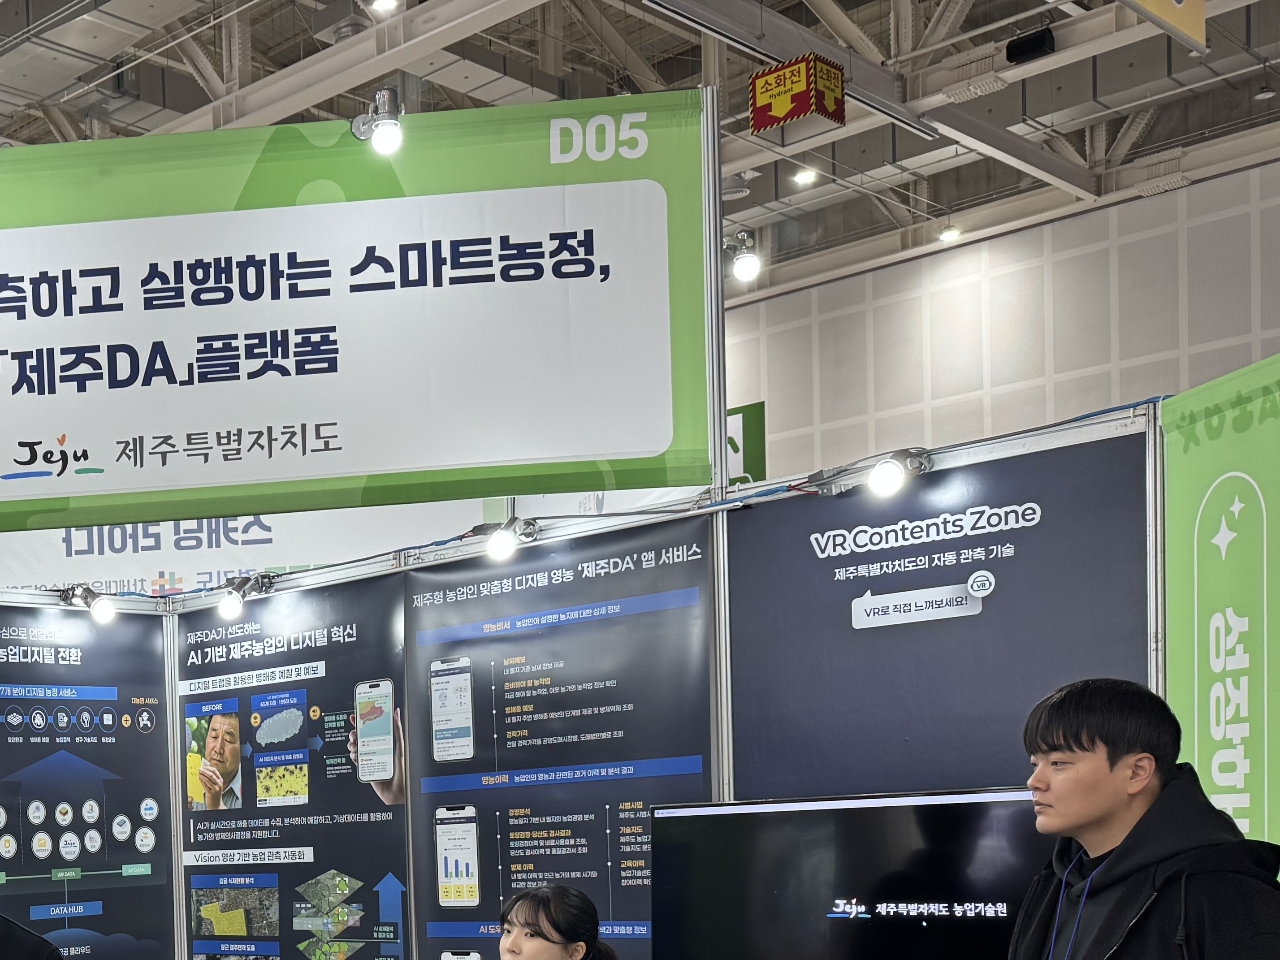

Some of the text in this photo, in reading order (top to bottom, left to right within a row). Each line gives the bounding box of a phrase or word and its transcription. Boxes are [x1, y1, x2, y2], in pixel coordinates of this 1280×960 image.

[760, 66, 801, 94] 소화전
[818, 66, 840, 89] 소화전
[769, 87, 794, 100] Hydrant
[549, 112, 648, 164] D05
[140, 251, 332, 311] 실행하는
[349, 228, 610, 293] 스마트농정,
[12, 422, 343, 477] Jeju 제주특별자치도
[813, 504, 1039, 556] VR Contents Zone
[833, 543, 1015, 581] 제주특별자치도의 자동 관측 기술
[412, 590, 445, 609] 제주형
[445, 584, 478, 602] 농업인
[480, 577, 513, 597] 맞춤형
[515, 571, 549, 592] 디지털
[550, 567, 574, 585] 영농
[641, 552, 655, 569] 앱
[658, 543, 703, 566] 서비스
[975, 582, 987, 590] VR
[864, 595, 969, 618] VR로 직접 느껴보세요!
[186, 621, 261, 644] 제주DA가 선도하는
[186, 623, 357, 666] AI 기반 제주농업의 디지털 혁신
[57, 648, 82, 666] 전환
[25, 688, 45, 697] 디지털
[58, 688, 78, 698] 서비스
[189, 681, 210, 692] 디지털
[201, 701, 223, 712] BEFORE
[618, 801, 643, 810] 시범사업
[619, 825, 644, 834] 기술지도
[193, 849, 305, 864] Vision 영상 기반 농업 관측 자동화
[50, 905, 84, 916] DATA HUB
[831, 899, 1008, 919] Jeju 제주특별자치도 농업기술원
[478, 925, 488, 934] AI
